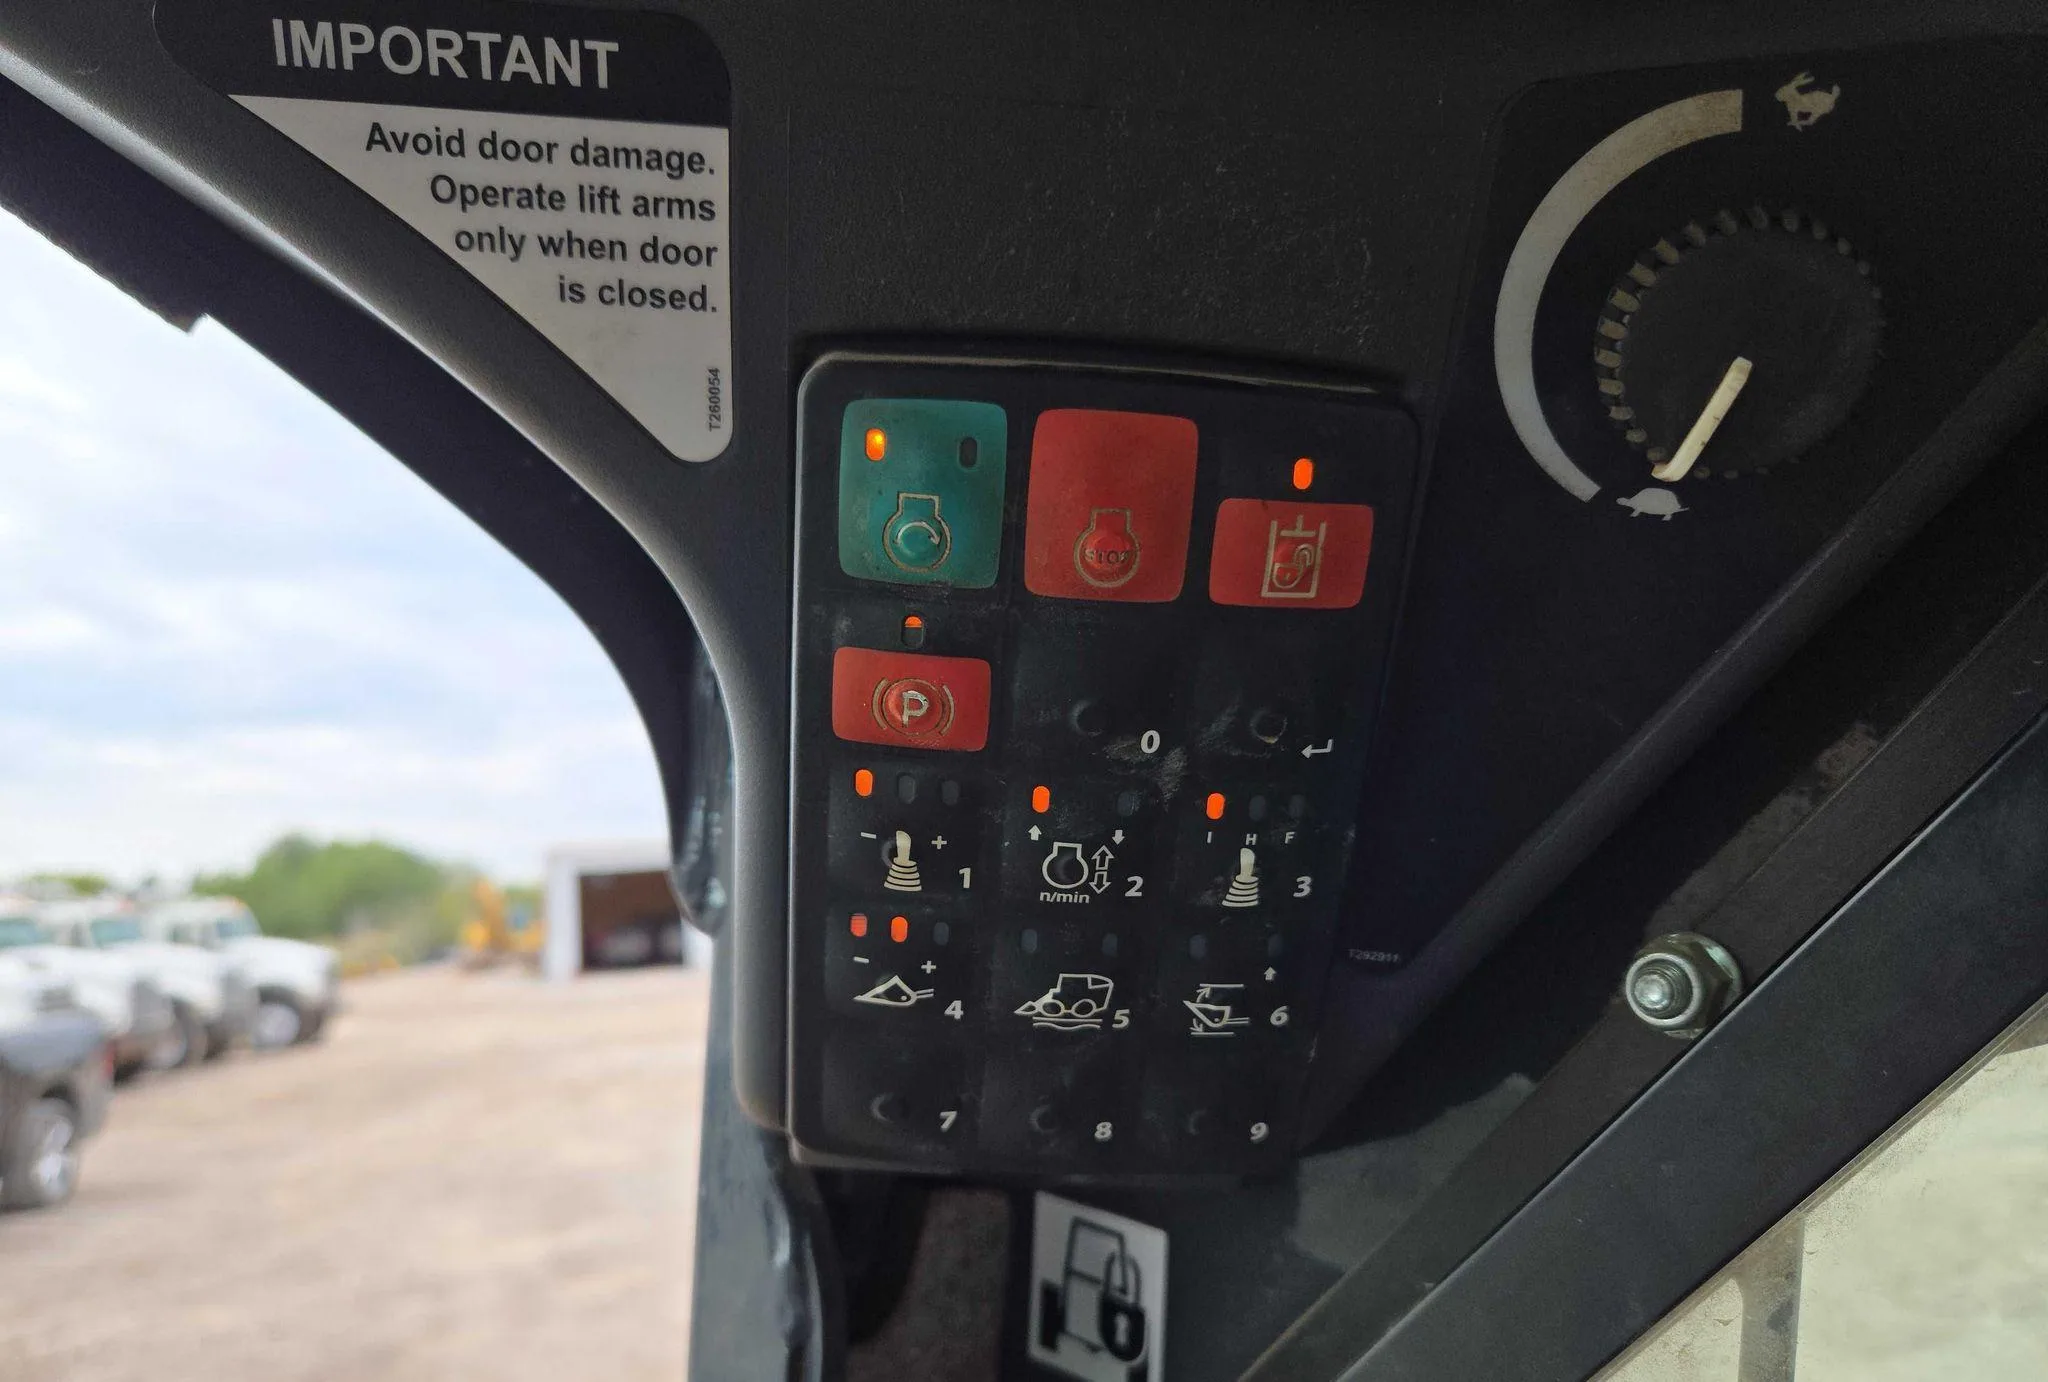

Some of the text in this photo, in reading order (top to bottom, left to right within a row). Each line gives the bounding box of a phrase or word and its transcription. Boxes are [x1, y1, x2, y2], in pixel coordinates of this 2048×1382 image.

[272, 18, 619, 89] IMPORTANT
[365, 122, 716, 178] Avoid door damage.
[430, 175, 717, 222] Operate lift arms
[454, 226, 718, 268] only when door
[559, 275, 719, 313] is closed.
[708, 367, 721, 431] T260054
[901, 691, 929, 727] P
[1140, 730, 1160, 754] 0
[1245, 833, 1257, 846] H
[1284, 831, 1295, 844] F
[958, 867, 971, 889] 1
[1124, 875, 1144, 897] 2
[1293, 875, 1312, 898] 3
[1039, 891, 1090, 904] n/min
[944, 1000, 964, 1020] 4
[1112, 1008, 1130, 1029] 5
[1269, 1005, 1289, 1026] 6
[939, 1110, 957, 1130] 7
[1094, 1121, 1112, 1140] 8
[1250, 1122, 1268, 1141] 9
